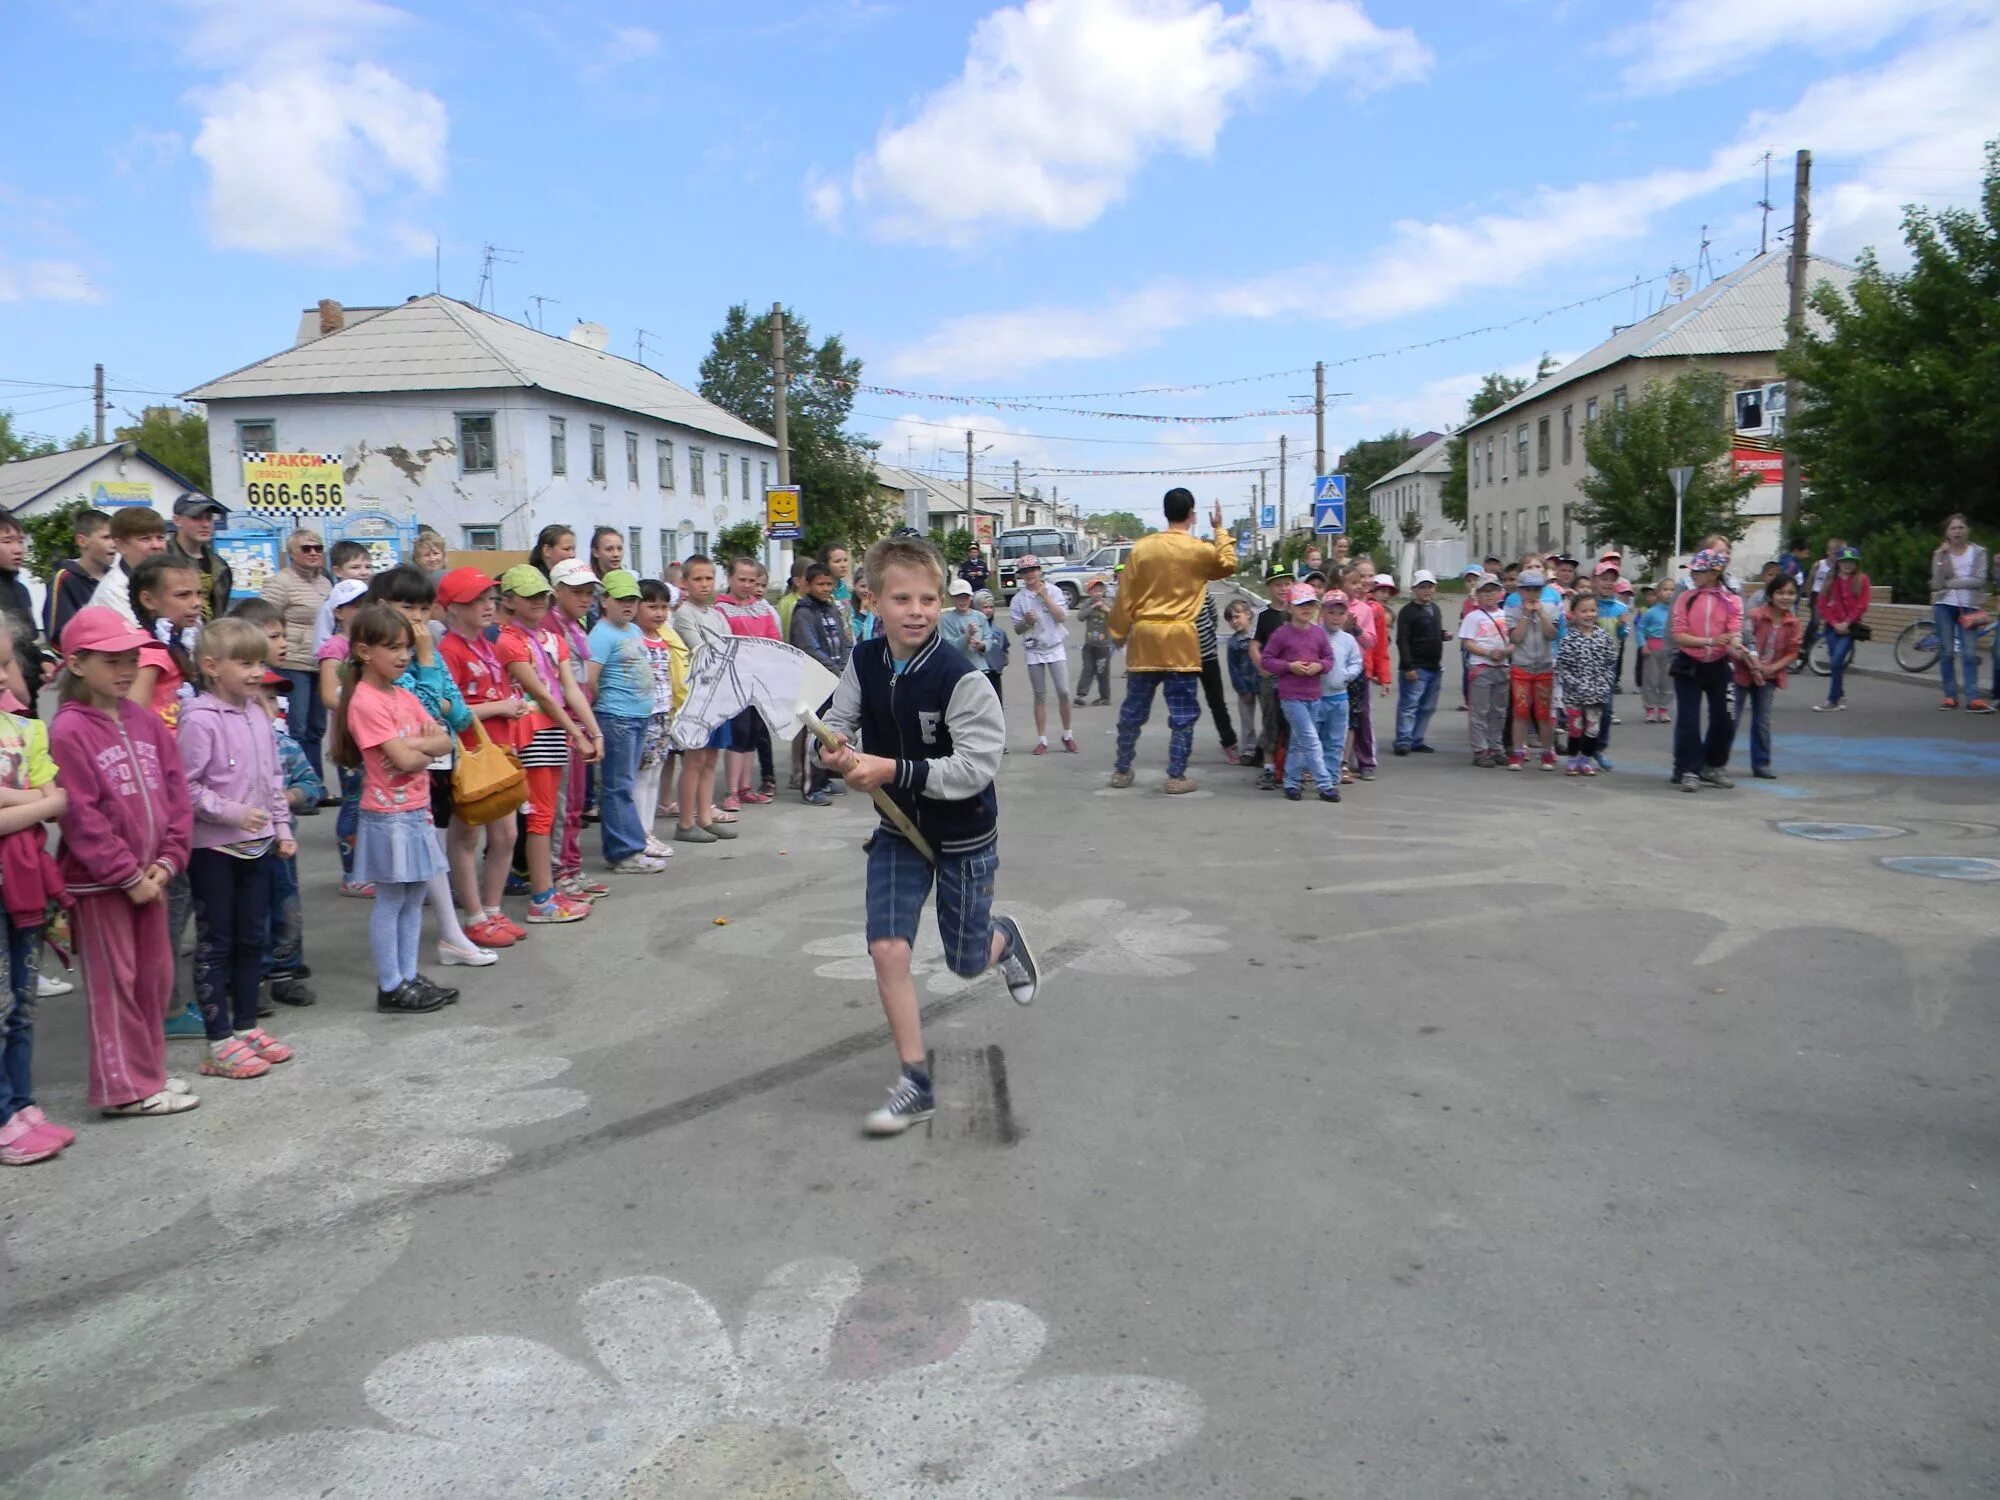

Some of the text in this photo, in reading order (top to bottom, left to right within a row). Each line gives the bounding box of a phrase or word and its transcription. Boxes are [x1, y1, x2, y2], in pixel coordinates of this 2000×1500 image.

[266, 454, 322, 467] ТАКСИ
[248, 482, 342, 505] 666-656
[918, 710, 941, 744] E
